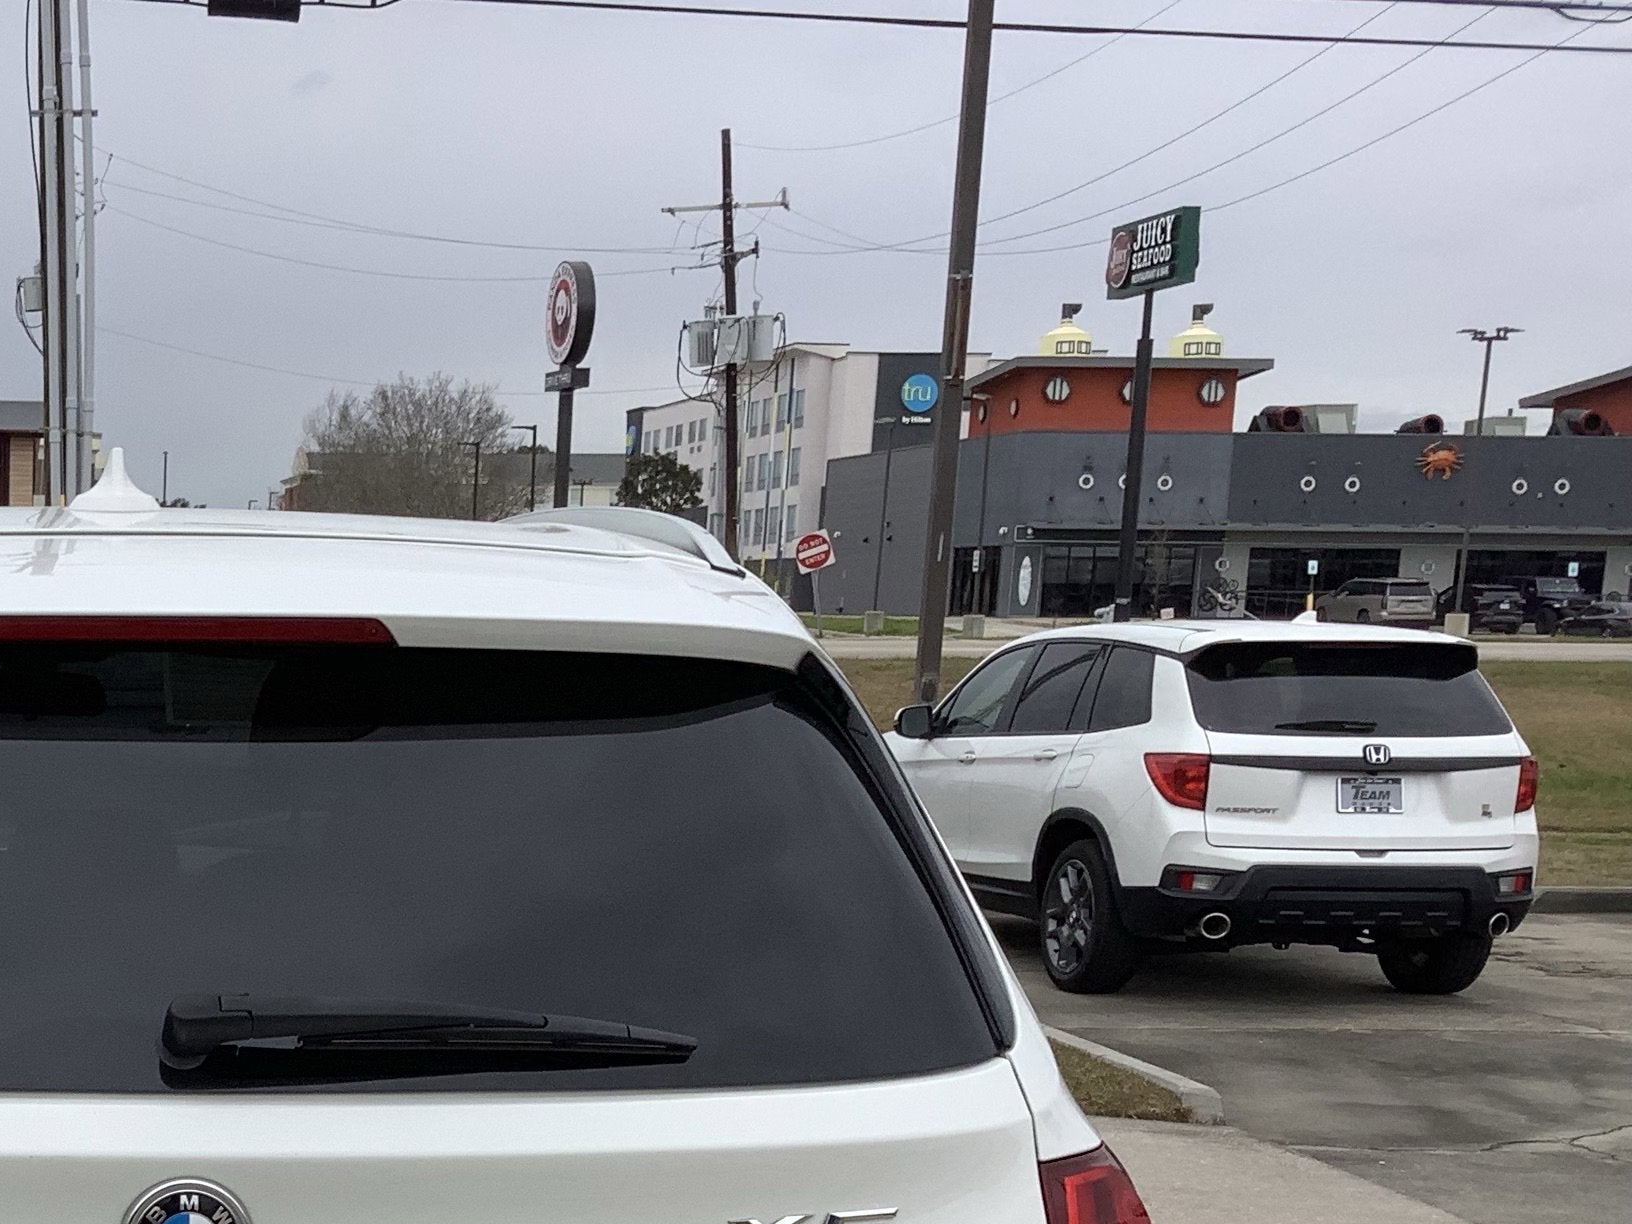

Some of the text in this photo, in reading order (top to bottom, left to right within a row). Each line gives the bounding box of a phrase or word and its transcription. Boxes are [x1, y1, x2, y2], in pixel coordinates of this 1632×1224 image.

[1133, 214, 1176, 251] JUICY
[1131, 243, 1172, 270] SEAFOOD
[903, 382, 931, 401] tru
[1351, 785, 1391, 801] TEAM
[1215, 806, 1280, 815] PASSPORT
